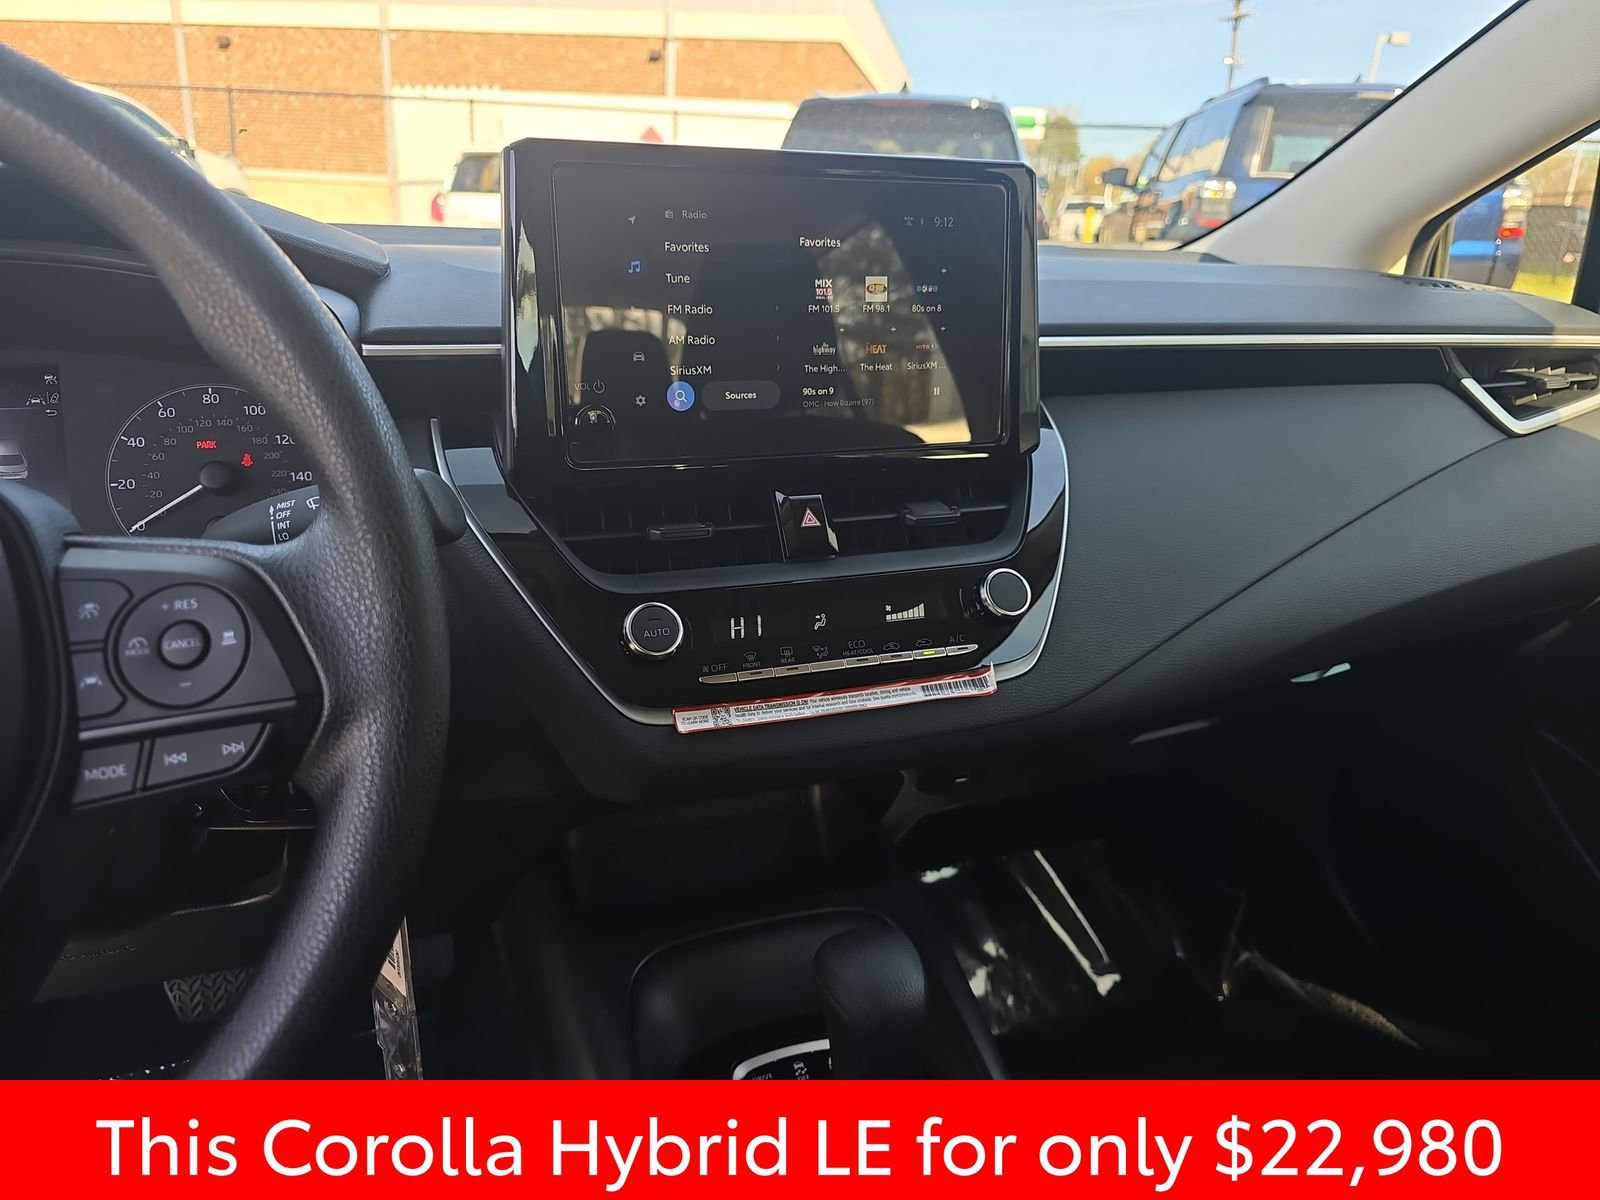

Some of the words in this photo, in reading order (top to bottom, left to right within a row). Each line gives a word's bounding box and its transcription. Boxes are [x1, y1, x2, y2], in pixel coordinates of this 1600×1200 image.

[682, 210, 707, 220] Radio
[934, 217, 954, 227] 9:12
[664, 241, 710, 253] Favorites
[799, 236, 841, 248] Favorites
[665, 273, 691, 284] Tune
[815, 279, 833, 287] MIX
[815, 287, 833, 296] 101.5
[667, 304, 682, 314] FM
[684, 304, 713, 315] Radio
[808, 304, 820, 313] FM
[821, 304, 841, 314] 101.5
[862, 304, 874, 313] FM
[875, 304, 891, 313] 98.1
[911, 304, 925, 313] 80s
[937, 304, 942, 313] 8
[668, 335, 685, 345] AM
[687, 335, 716, 345] Radio
[865, 343, 887, 354] HEAT
[669, 365, 712, 376] SiriusXM
[804, 364, 819, 373] The
[859, 363, 873, 372] The
[874, 363, 893, 372] Heat
[573, 383, 591, 391] VOL
[802, 387, 817, 396] 90s
[817, 388, 828, 396] on
[828, 387, 835, 396] 9
[202, 393, 220, 404] 80
[724, 391, 757, 400] Sources
[802, 400, 820, 408] OMC
[824, 399, 839, 408] How
[158, 407, 176, 418] 60
[243, 404, 266, 416] 100
[194, 418, 212, 428] 120
[216, 417, 233, 428] 140
[176, 424, 194, 434] 100
[236, 423, 254, 433] 160
[127, 436, 145, 448] 40
[163, 437, 177, 446] 80
[196, 440, 217, 449] PARK
[251, 436, 268, 445] 180
[152, 452, 165, 461] 60
[263, 451, 280, 460] 200
[146, 471, 160, 480] 40
[271, 469, 287, 478] 220
[289, 471, 313, 482] 140
[117, 478, 136, 490] 20
[149, 490, 163, 499] 20
[276, 499, 296, 509] MIST
[275, 509, 292, 520] OFF
[277, 520, 291, 530] INT
[277, 532, 290, 541] LO
[173, 598, 199, 611] RES
[729, 614, 763, 640] HI
[643, 626, 671, 639] AUTO
[948, 633, 966, 644] A/C
[163, 638, 202, 650] CANCEL
[847, 639, 866, 650] ECO
[842, 647, 875, 657] HEAT/COOL
[710, 662, 729, 673] OFF
[742, 661, 762, 669] FRONT
[84, 763, 128, 782] MODE
